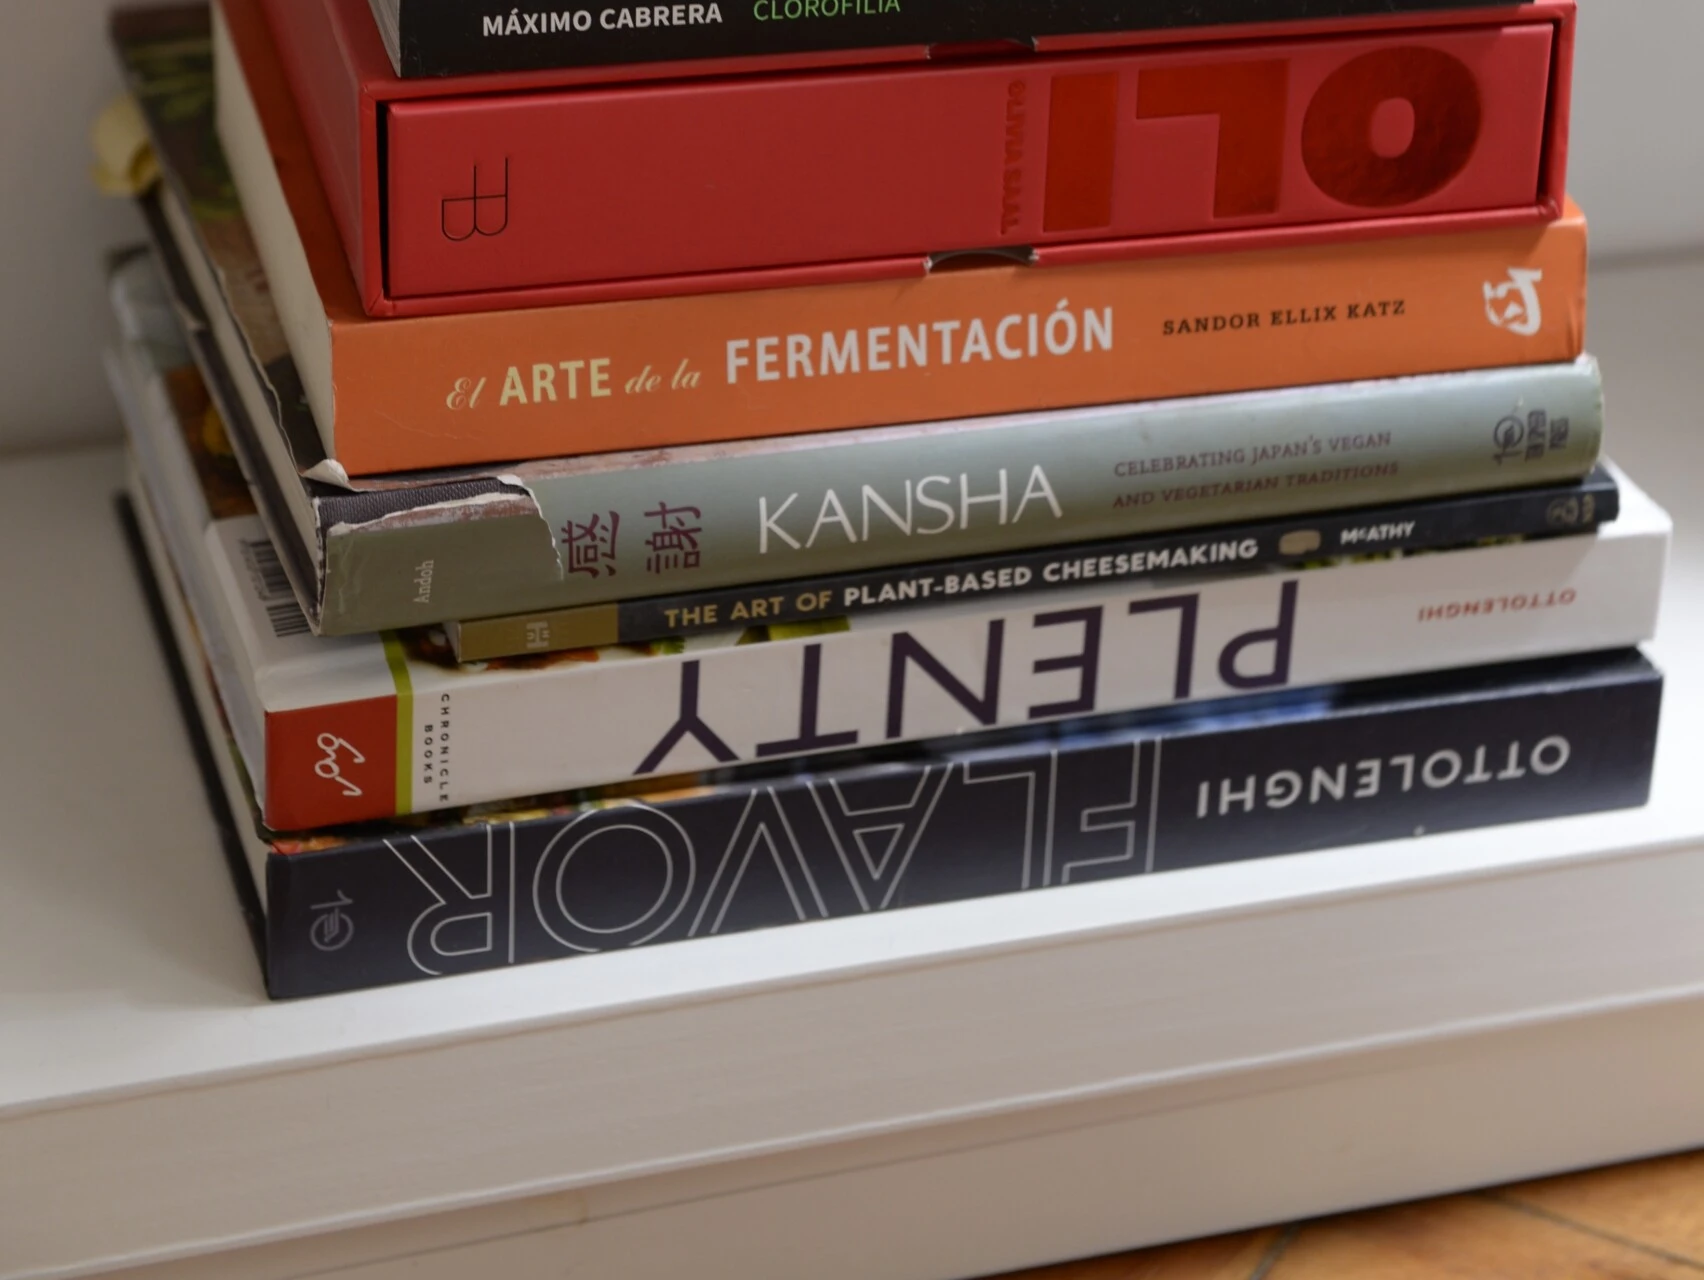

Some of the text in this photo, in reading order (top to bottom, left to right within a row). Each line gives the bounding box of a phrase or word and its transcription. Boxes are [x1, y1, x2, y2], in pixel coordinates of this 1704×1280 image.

[482, 2, 723, 37] MÁXIMO CABRERA
[445, 297, 1113, 410] El ARTE de la FERMENTACIÓN
[1161, 299, 1406, 337] SANDOR ELLIX KATZ
[1112, 460, 1400, 510] AND VEGETARIAN TRADITIONS
[1113, 430, 1393, 478] CELEBRATING JAPAN'S VEGAN
[560, 501, 703, 579] 感謝
[757, 463, 1063, 555] KANSHA
[412, 558, 435, 605] Andoh
[663, 536, 1260, 629] THE ART OF PLANT-BASED CHEESEMAKING
[1416, 587, 1577, 623] OTTOLENGHI
[631, 579, 1299, 776] PLENTY
[423, 723, 434, 785] BOOKS
[438, 692, 451, 803] CHRONICLE
[1196, 734, 1572, 820] OTTOLENGHI
[382, 734, 1162, 976] FLAVOR
